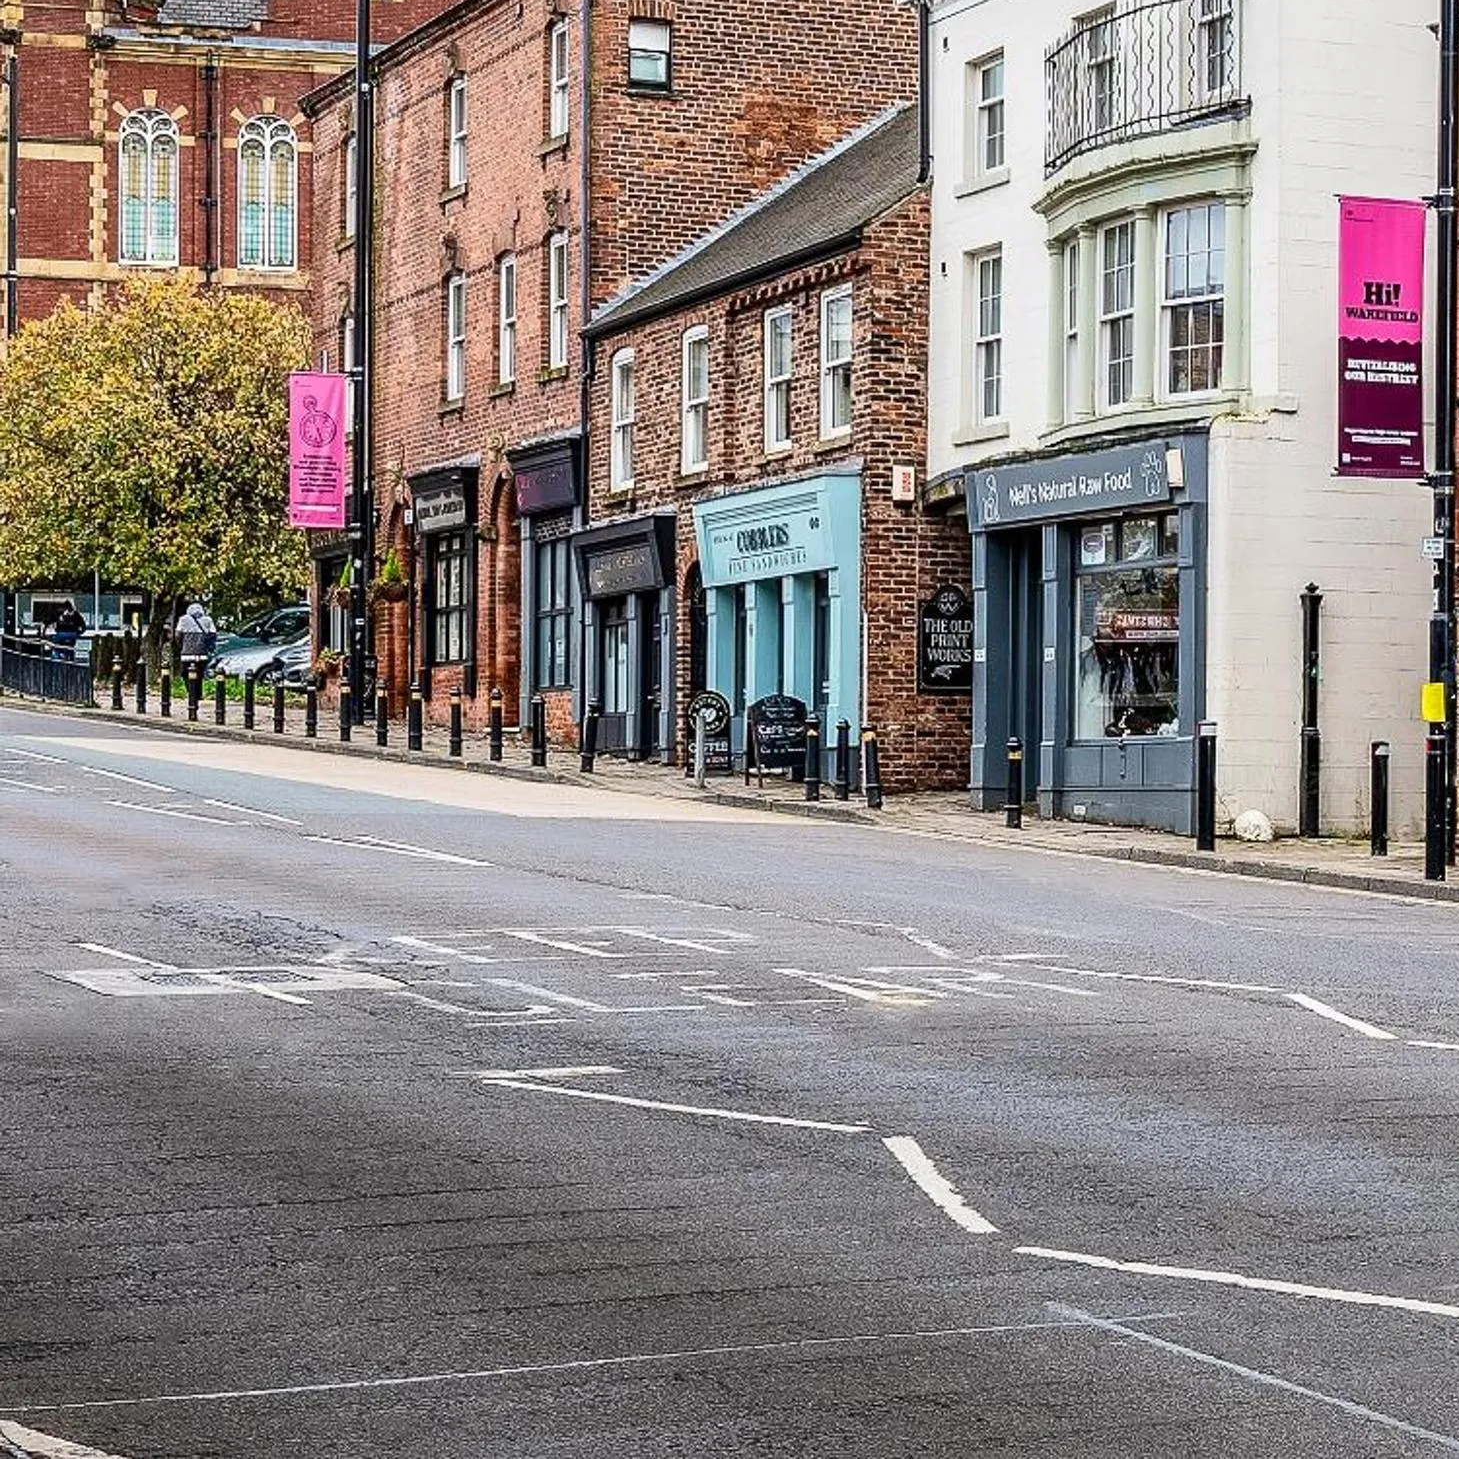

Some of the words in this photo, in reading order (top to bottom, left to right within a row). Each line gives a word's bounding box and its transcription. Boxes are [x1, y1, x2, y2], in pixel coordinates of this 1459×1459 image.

[1363, 281, 1402, 308] Hi!
[1345, 306, 1419, 323] WAKEFIELD
[1038, 476, 1077, 503] Natural
[1080, 475, 1102, 497] Raw
[1104, 466, 1133, 493] Food
[924, 618, 948, 633] THE
[950, 619, 973, 633] OLD
[931, 634, 969, 648] PRINT
[927, 648, 972, 663] WORKS
[310, 925, 757, 966] EEP
